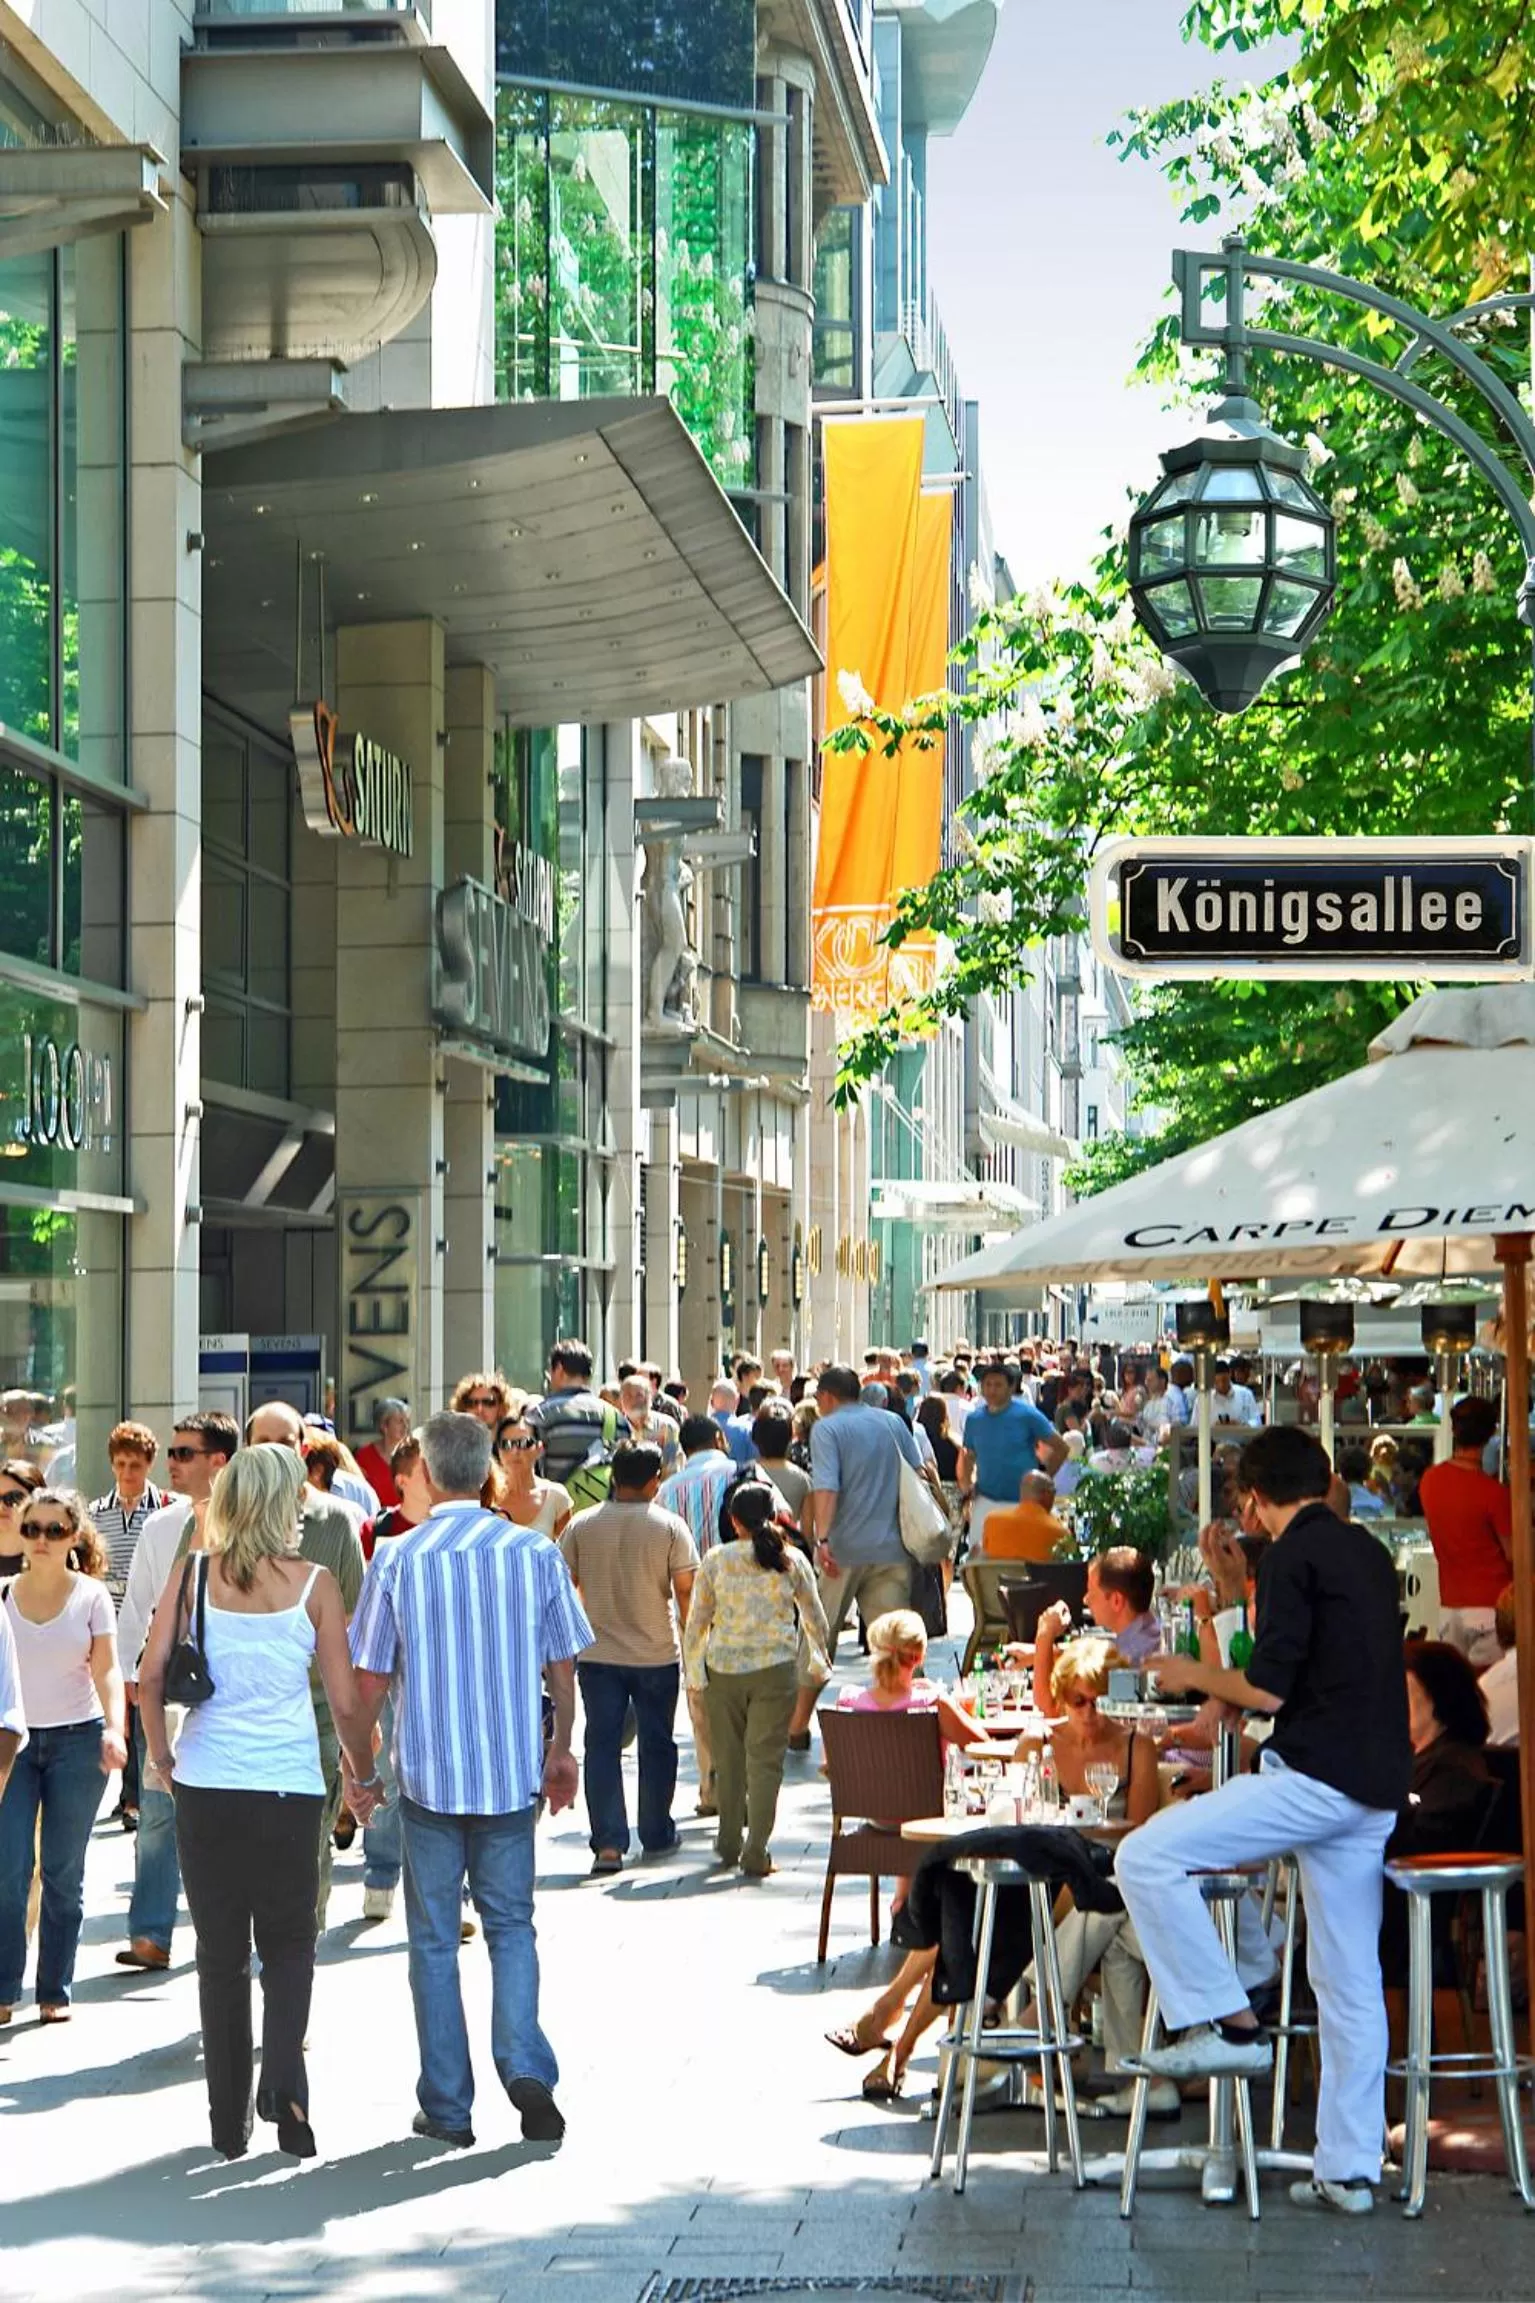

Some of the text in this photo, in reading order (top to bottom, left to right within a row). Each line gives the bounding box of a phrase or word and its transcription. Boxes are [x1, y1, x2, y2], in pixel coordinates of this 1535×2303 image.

[355, 731, 413, 858] SATURN
[433, 875, 550, 1057] SEVENS
[1157, 876, 1483, 944] Königsallee
[1124, 1204, 1535, 1247] CARPE DIEM
[348, 1205, 411, 1434] EVENS
